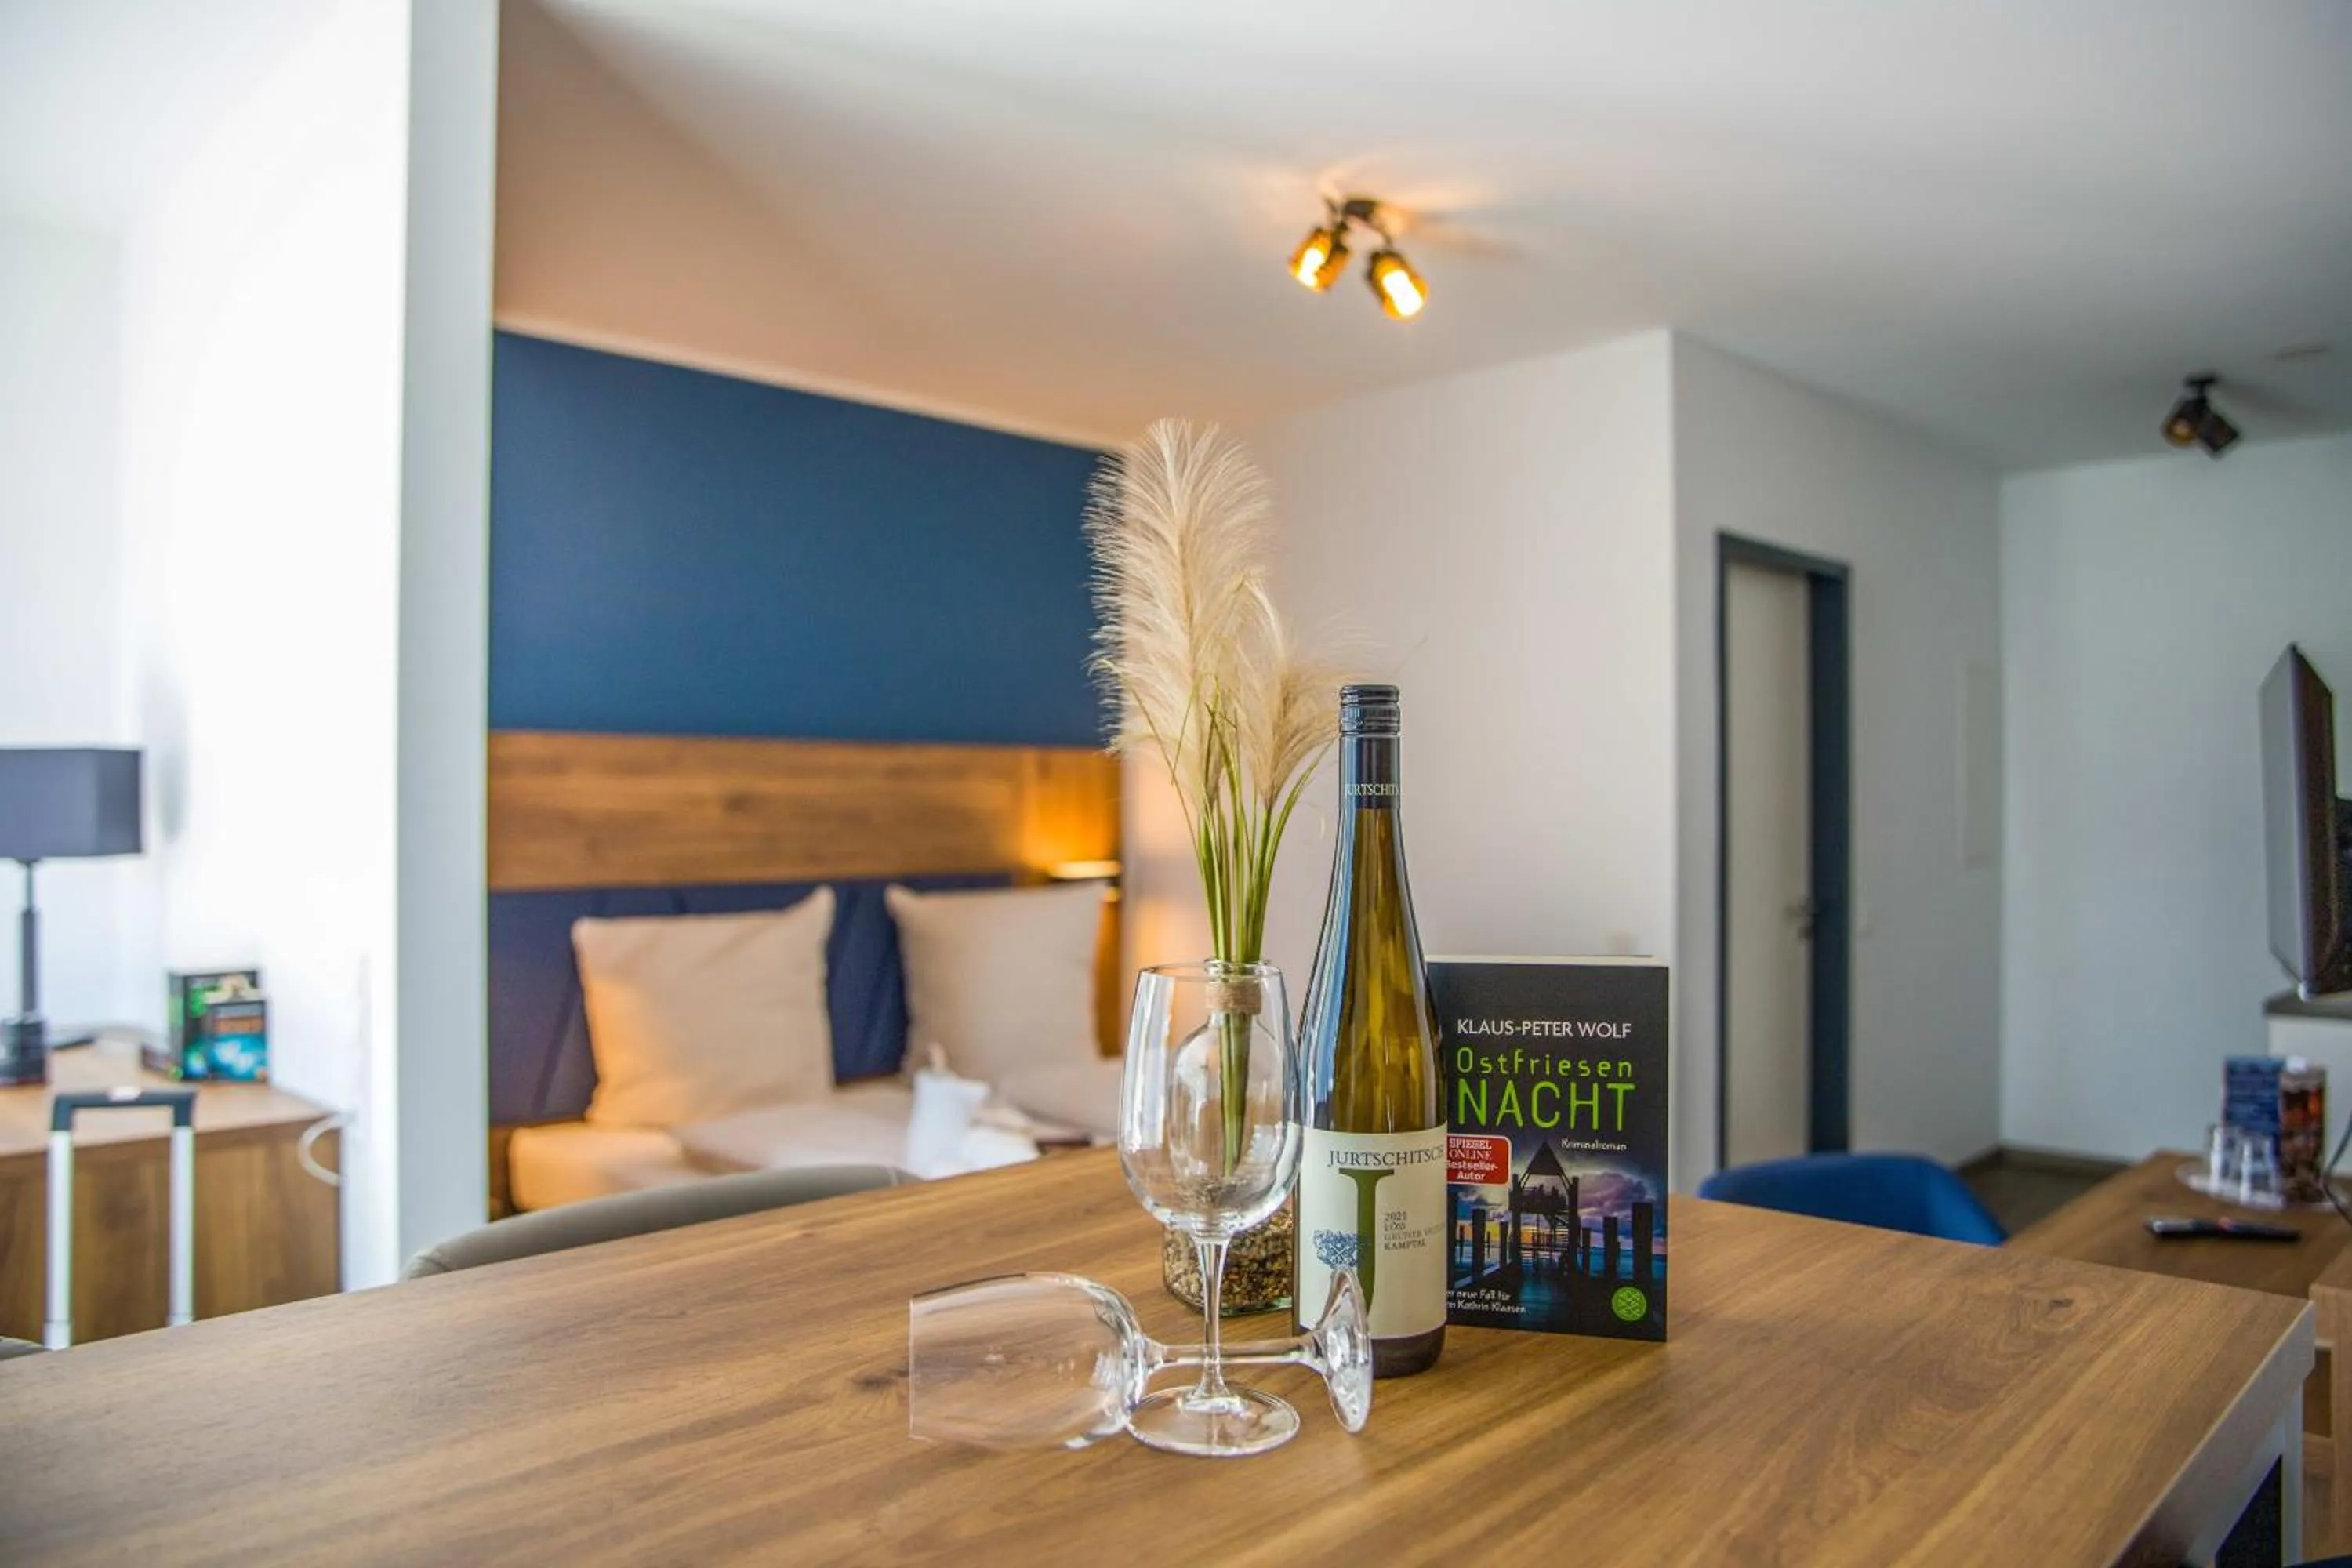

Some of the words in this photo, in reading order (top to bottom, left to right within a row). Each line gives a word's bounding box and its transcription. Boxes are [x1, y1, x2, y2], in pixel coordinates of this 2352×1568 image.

[1457, 1018, 1573, 1037] KLAUS-PETER
[1577, 1022, 1632, 1039] WOLF
[1457, 1047, 1632, 1078] Ostfriesen
[1457, 1078, 1636, 1131] NACHT
[1449, 1138, 1492, 1150] SPIEGEL
[1560, 1137, 1628, 1151] Kriminalroman
[1448, 1149, 1492, 1160] ONLINE
[1457, 1171, 1486, 1180] Autor
